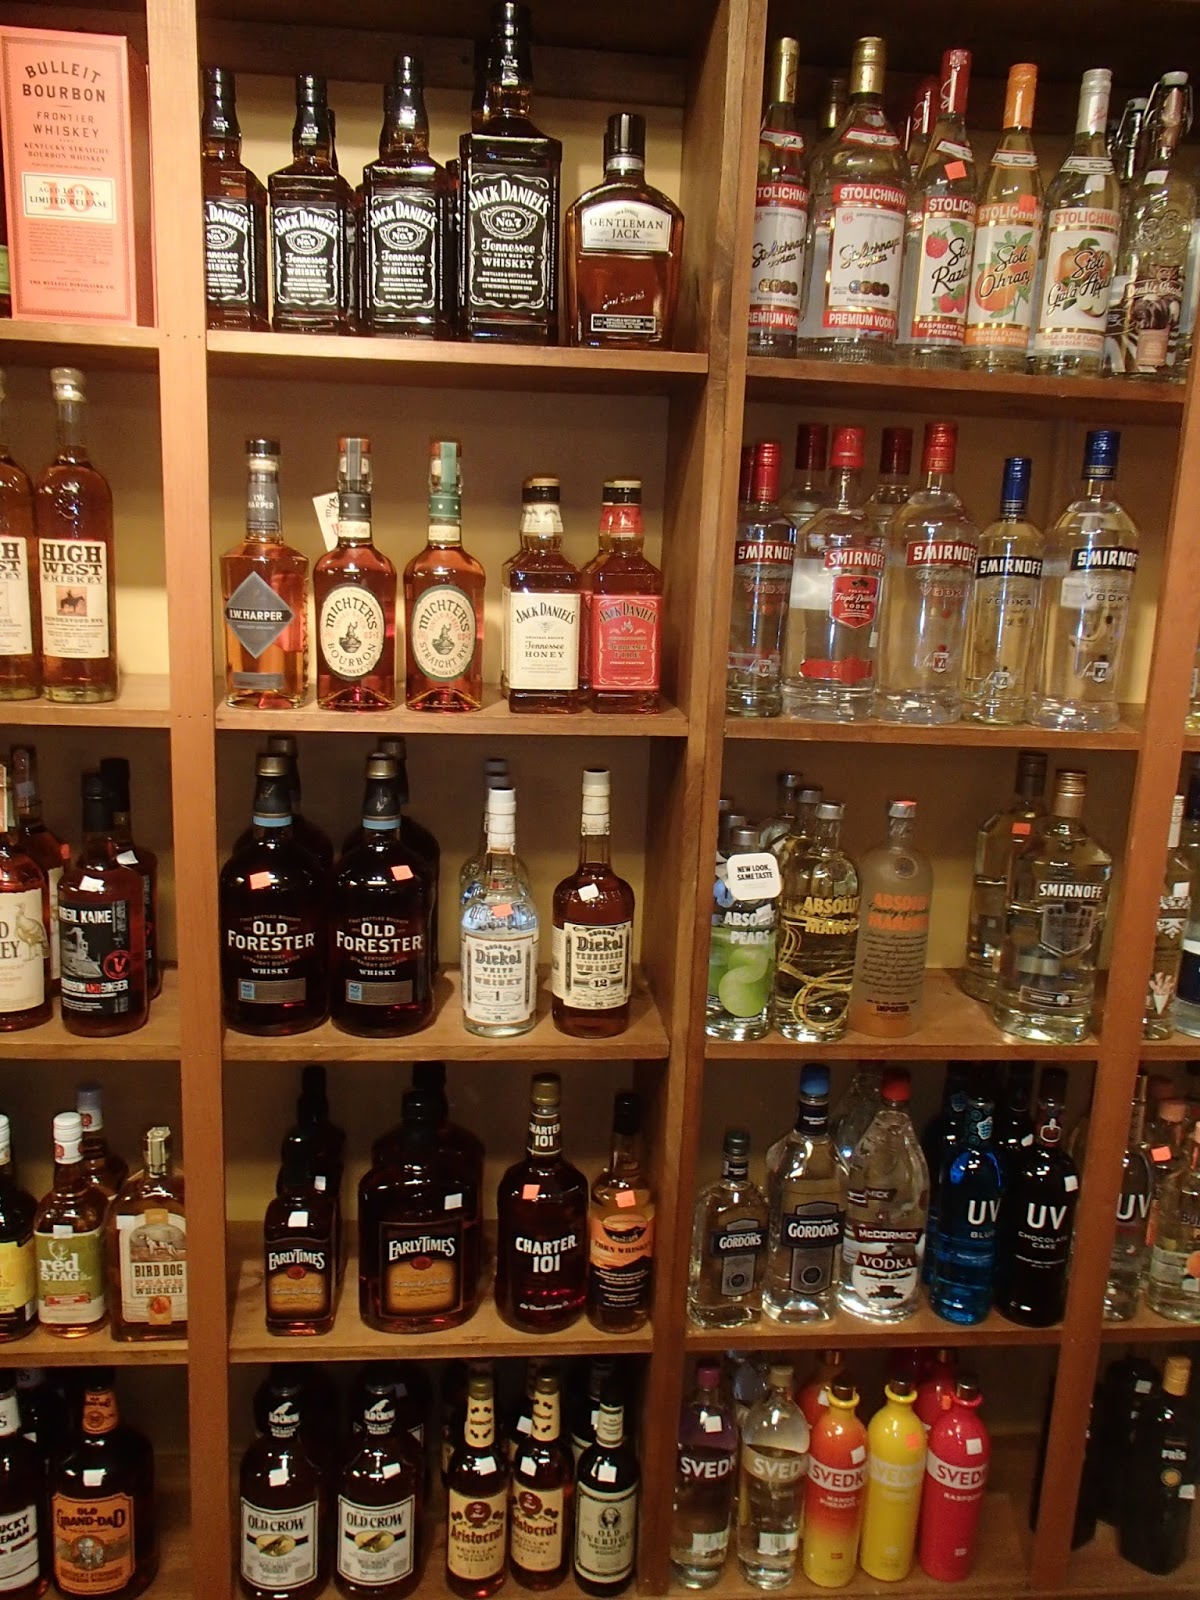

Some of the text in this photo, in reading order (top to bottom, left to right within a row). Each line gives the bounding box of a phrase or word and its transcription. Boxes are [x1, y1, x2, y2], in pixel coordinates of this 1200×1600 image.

[25, 61, 101, 83] BULLEIT
[23, 84, 106, 102] BOURBON
[36, 111, 94, 124] FRONTIER
[33, 124, 99, 139] WHISKEY
[29, 196, 107, 208] LIMITED RELEASE
[468, 179, 552, 216] JACK DANIEL'S
[370, 200, 438, 231] JACK DANIEL'S
[495, 217, 522, 229] No.7
[589, 217, 664, 230] GENTLEMAN
[274, 210, 340, 239] JACK DANIEL'S
[612, 228, 640, 239] JACK
[481, 237, 536, 254] Tennessee
[285, 252, 328, 265] Tennessee
[381, 250, 426, 262] Tennessee
[481, 257, 535, 269] WHISKEY
[994, 245, 1028, 273] Stoli
[286, 267, 328, 277] WHISKEY
[382, 266, 425, 276] WHISKEY
[1072, 250, 1105, 280] Stoli
[1048, 283, 1077, 316] Gala
[829, 312, 873, 326] PREMIUM
[42, 543, 102, 563] HIGH
[737, 544, 794, 561] SMIRNOF
[1077, 549, 1138, 569] SMIRNOF
[42, 562, 103, 576] WEST
[979, 558, 1042, 577] SMIRNOFF
[42, 574, 103, 584] WHISKEY
[325, 597, 379, 630] MICHTER'S
[418, 599, 471, 633] MICHTER'S
[515, 602, 577, 625] JACK DANIEL'S
[599, 601, 658, 624] JACK DANIEL'S
[525, 640, 565, 650] Tennessee
[327, 643, 377, 667] BOURBON
[418, 641, 470, 668] STRAIGHT RYE
[736, 865, 751, 873] NEW
[736, 871, 774, 881] SAME TASTE
[1038, 882, 1103, 898] SMIRNOFF
[252, 920, 288, 935] OLD
[360, 922, 396, 937] OLD
[227, 929, 315, 951] FORESTER
[336, 930, 423, 953] FORESTER
[576, 934, 623, 952] Dickel
[730, 930, 770, 945] PEARS
[475, 948, 522, 966] Dickel
[575, 950, 623, 961] TENNESSEE
[251, 967, 290, 975] WHISKY
[359, 968, 397, 976] WHISKY
[593, 979, 608, 988] 12
[534, 1134, 554, 1147] 101
[967, 1199, 1001, 1226] UV
[1115, 1193, 1152, 1221] UV
[1026, 1202, 1068, 1230] UV
[787, 1222, 840, 1239] GORDON'S
[388, 1236, 456, 1261] EARLY TIMES
[515, 1234, 578, 1256] CHARTER
[718, 1233, 762, 1250] GORDON'S
[39, 1253, 81, 1273] red
[268, 1248, 326, 1271] EARLY TIMES
[532, 1256, 561, 1273] 101
[861, 1254, 913, 1270] VODKA
[40, 1271, 80, 1282] STAG
[134, 1263, 184, 1278] BIRD DOG
[135, 1278, 184, 1288] PEACH
[135, 1286, 184, 1296] WHISKEY
[248, 1515, 306, 1531] OLD CROW
[346, 1511, 404, 1528] OLD CROW
